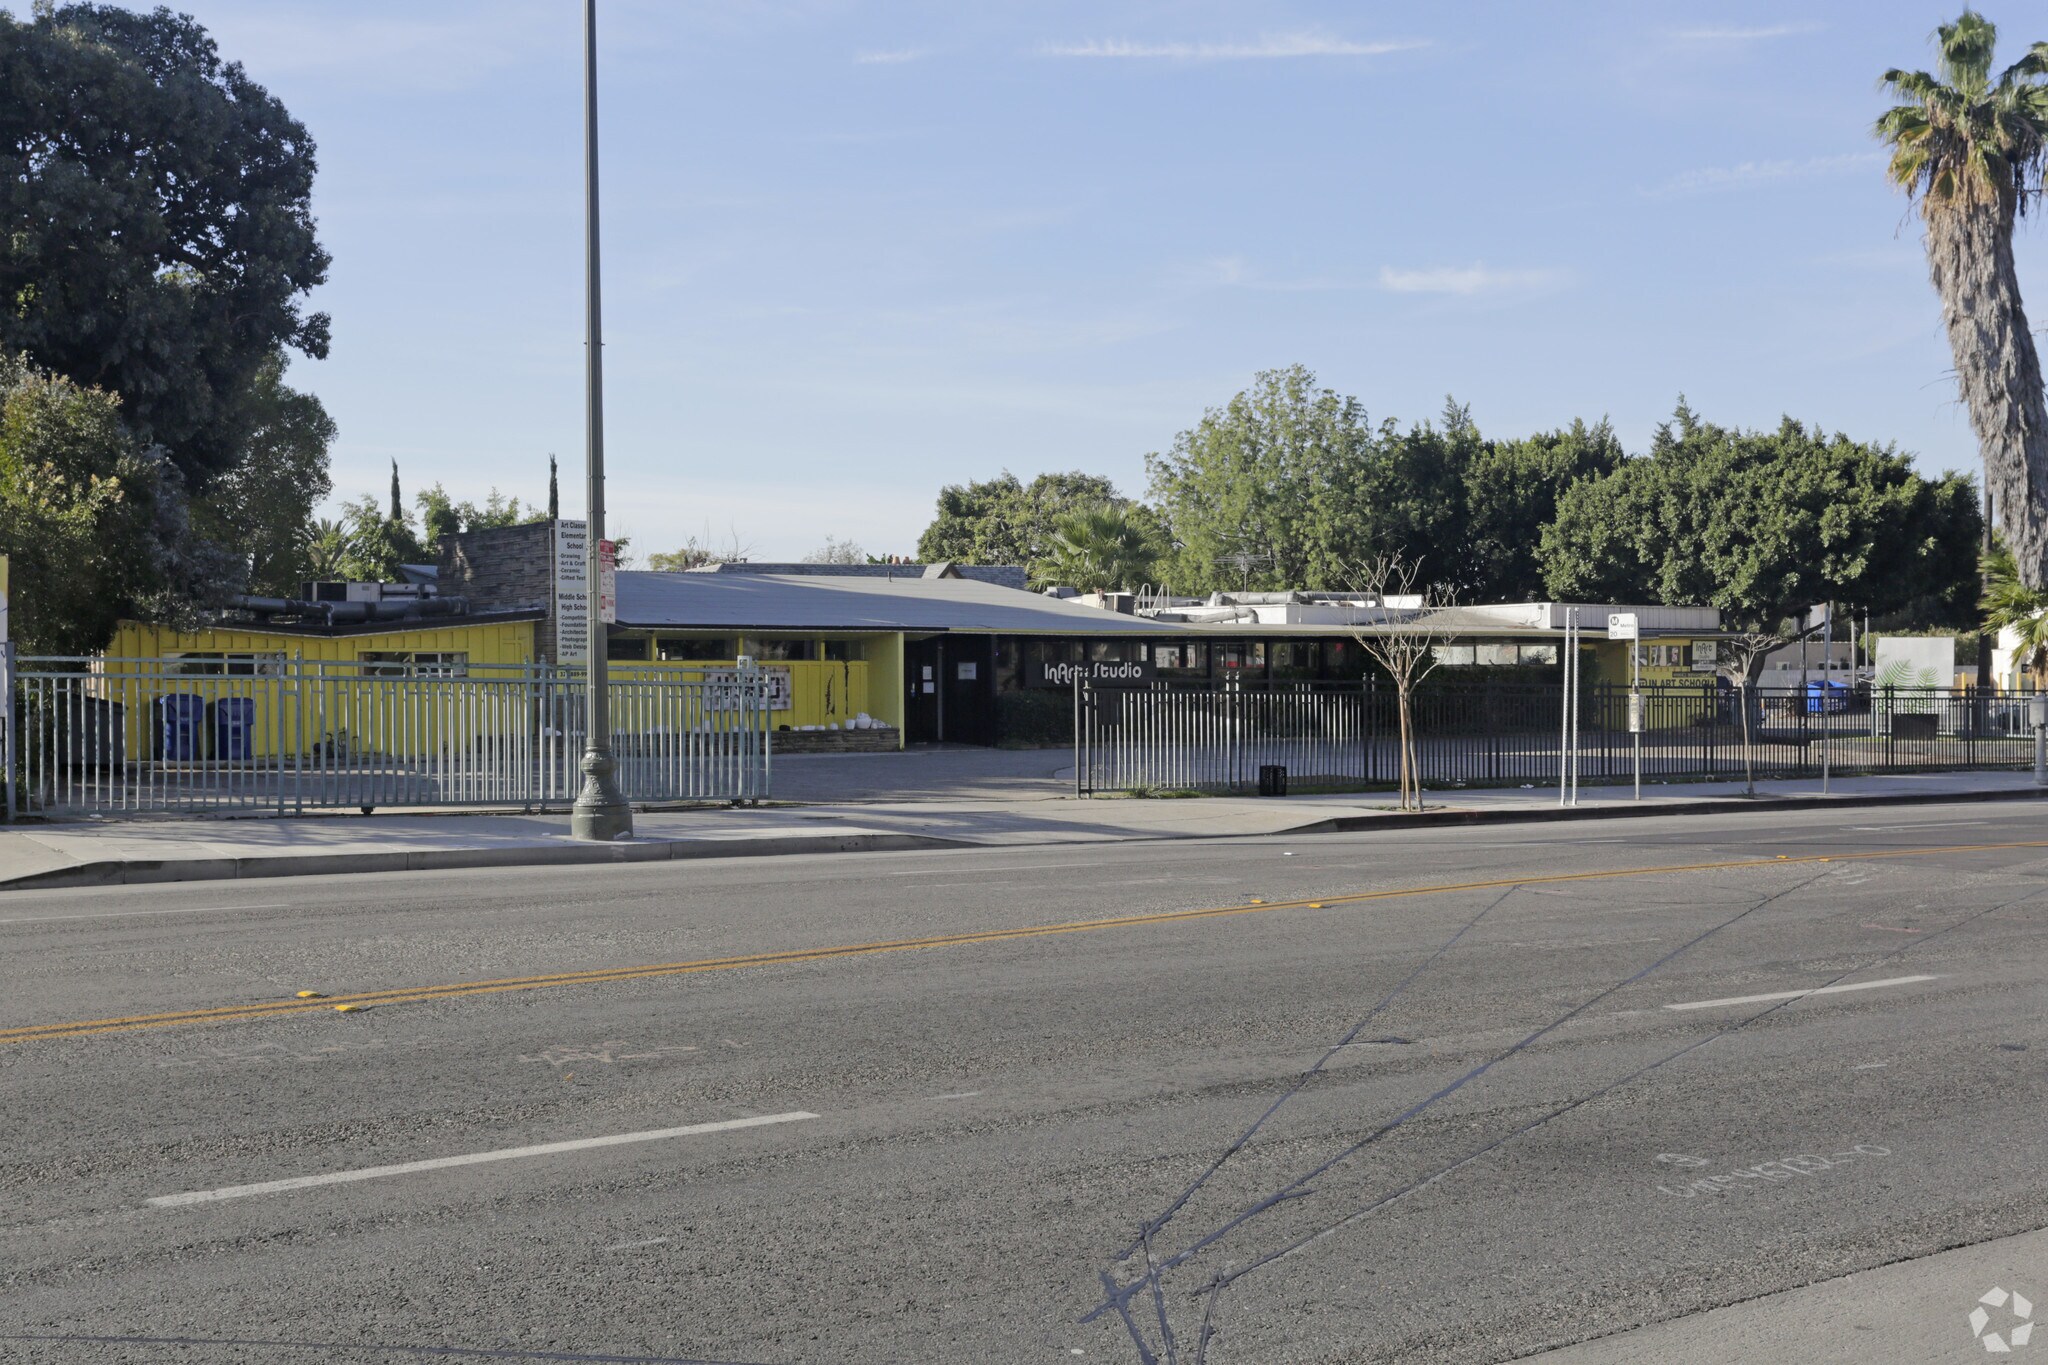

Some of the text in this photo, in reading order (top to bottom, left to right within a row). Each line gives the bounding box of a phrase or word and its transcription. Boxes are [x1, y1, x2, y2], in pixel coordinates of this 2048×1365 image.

[561, 603, 573, 612] High
[1696, 643, 1712, 654] InArt
[1092, 662, 1142, 678] Studio
